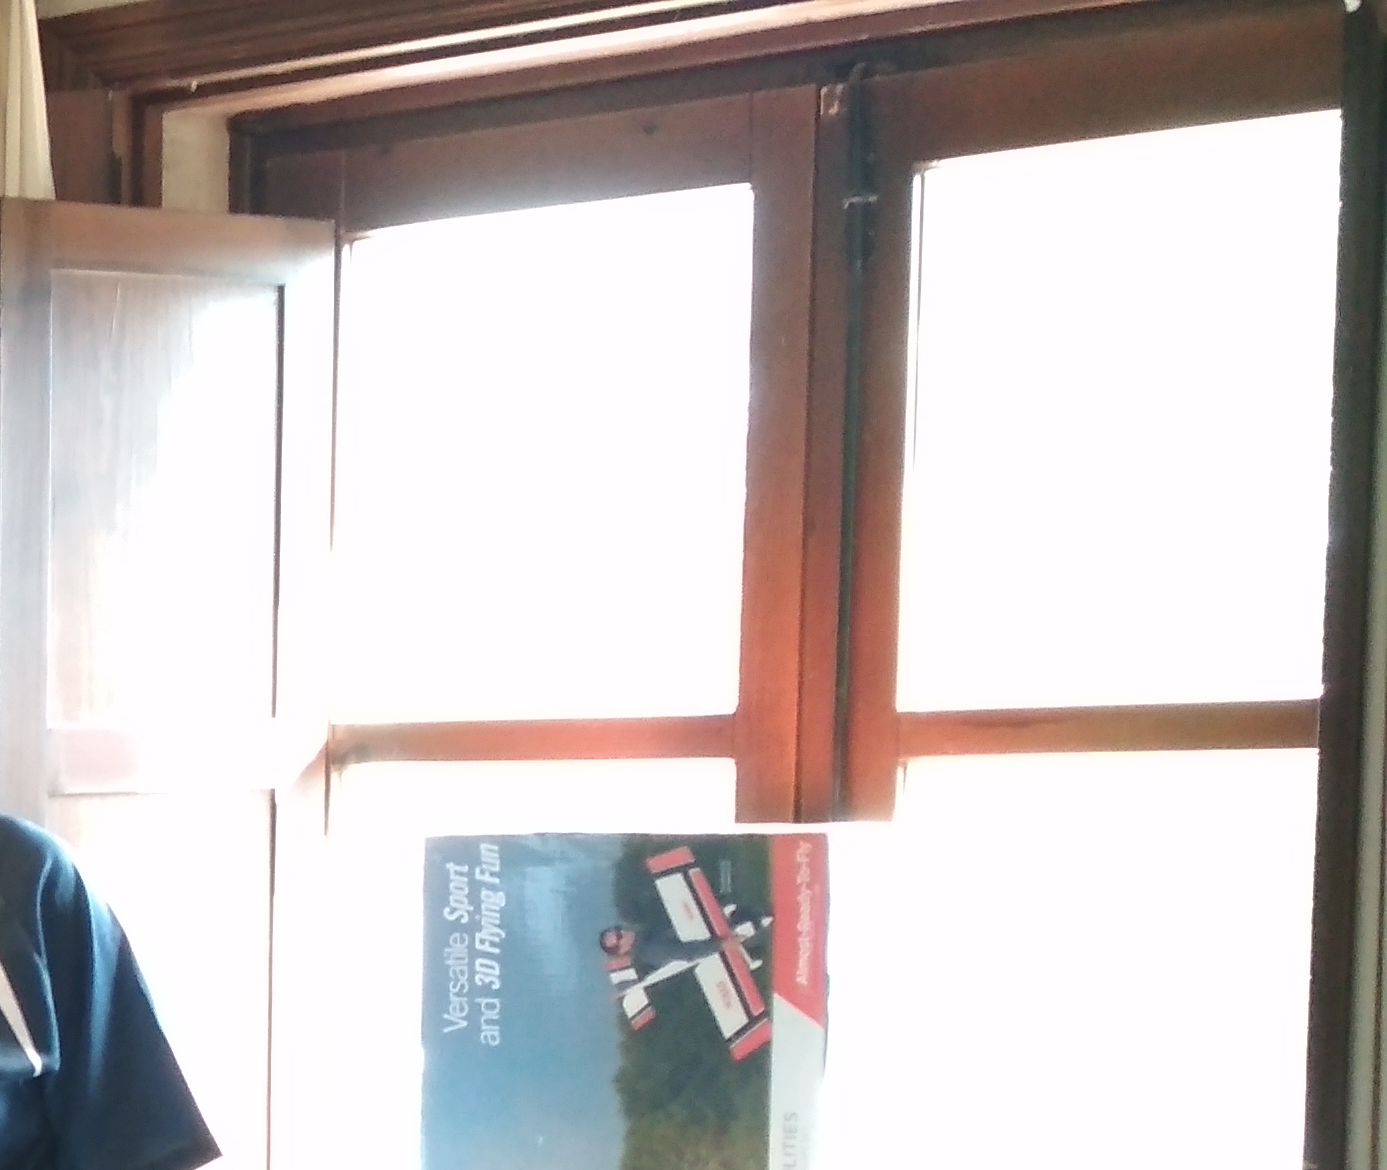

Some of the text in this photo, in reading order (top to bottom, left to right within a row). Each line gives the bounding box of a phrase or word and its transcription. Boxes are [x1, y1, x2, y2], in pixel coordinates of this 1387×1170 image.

[442, 861, 474, 1034] Versatile Sport
[474, 842, 506, 1046] and 3D Flying Fun
